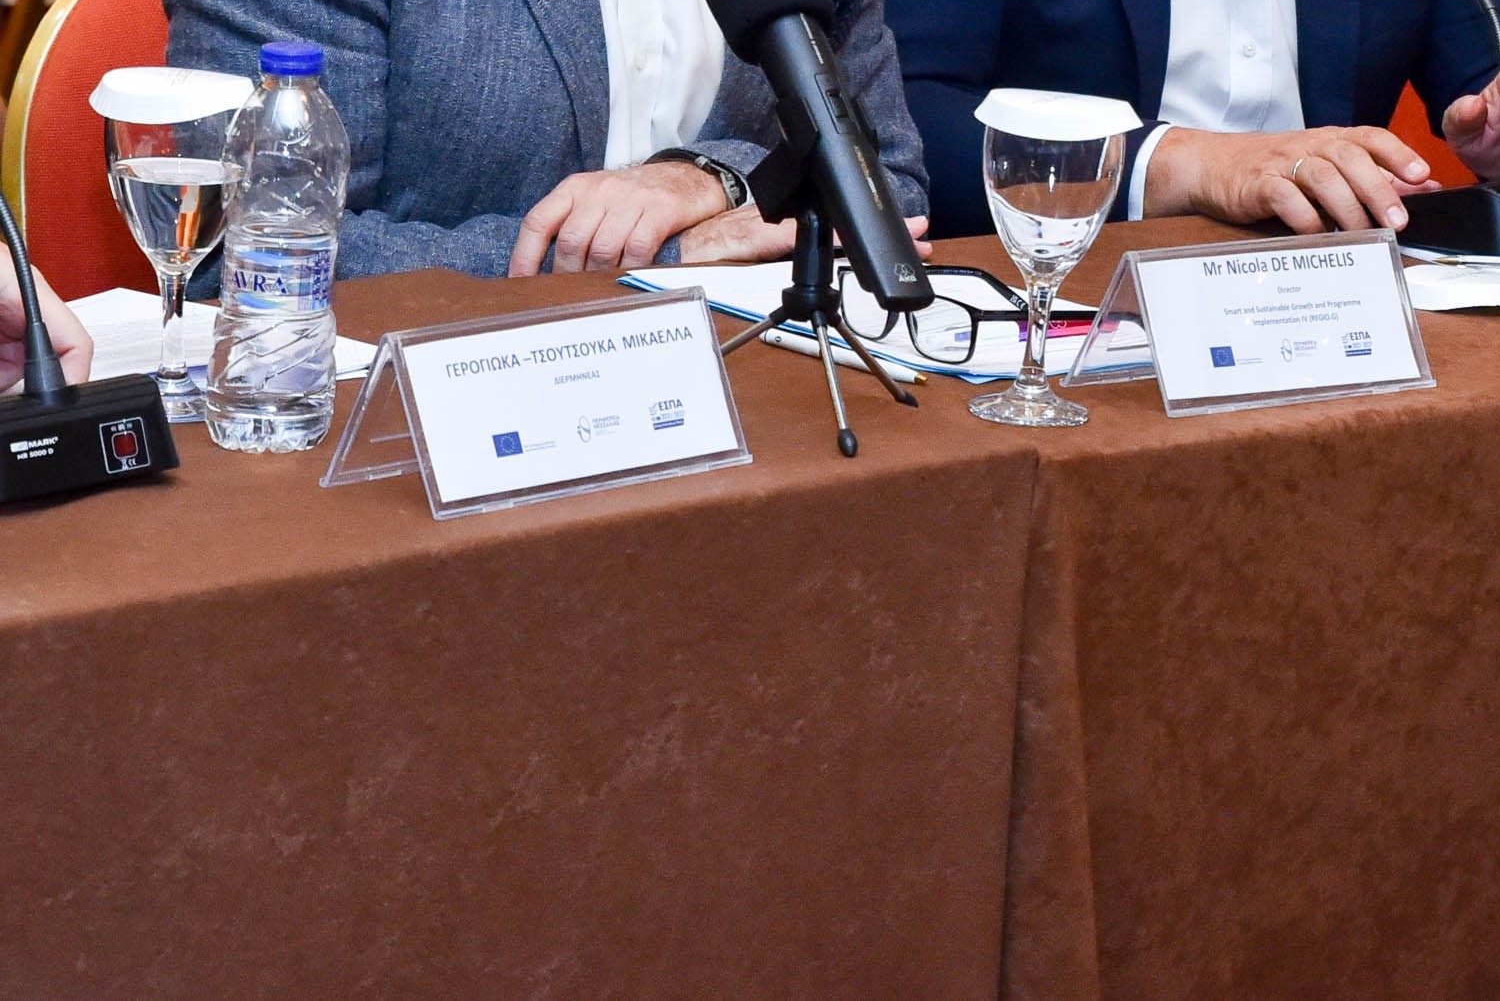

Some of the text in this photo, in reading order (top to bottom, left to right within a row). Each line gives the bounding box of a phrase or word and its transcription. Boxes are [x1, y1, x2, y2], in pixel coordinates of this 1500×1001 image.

[1203, 252, 1355, 277] Mr Nicola DE MICHELIS
[1277, 286, 1301, 294] Director
[1224, 307, 1242, 315] Smart
[1291, 302, 1313, 311] Growth
[1315, 300, 1326, 308] and
[446, 353, 521, 378] ΓΕΡΟΓΙΩΚΑ
[622, 326, 693, 350] ΜΙΚΑΕΛΛΑ
[658, 398, 683, 411] ΕΣΠΑ
